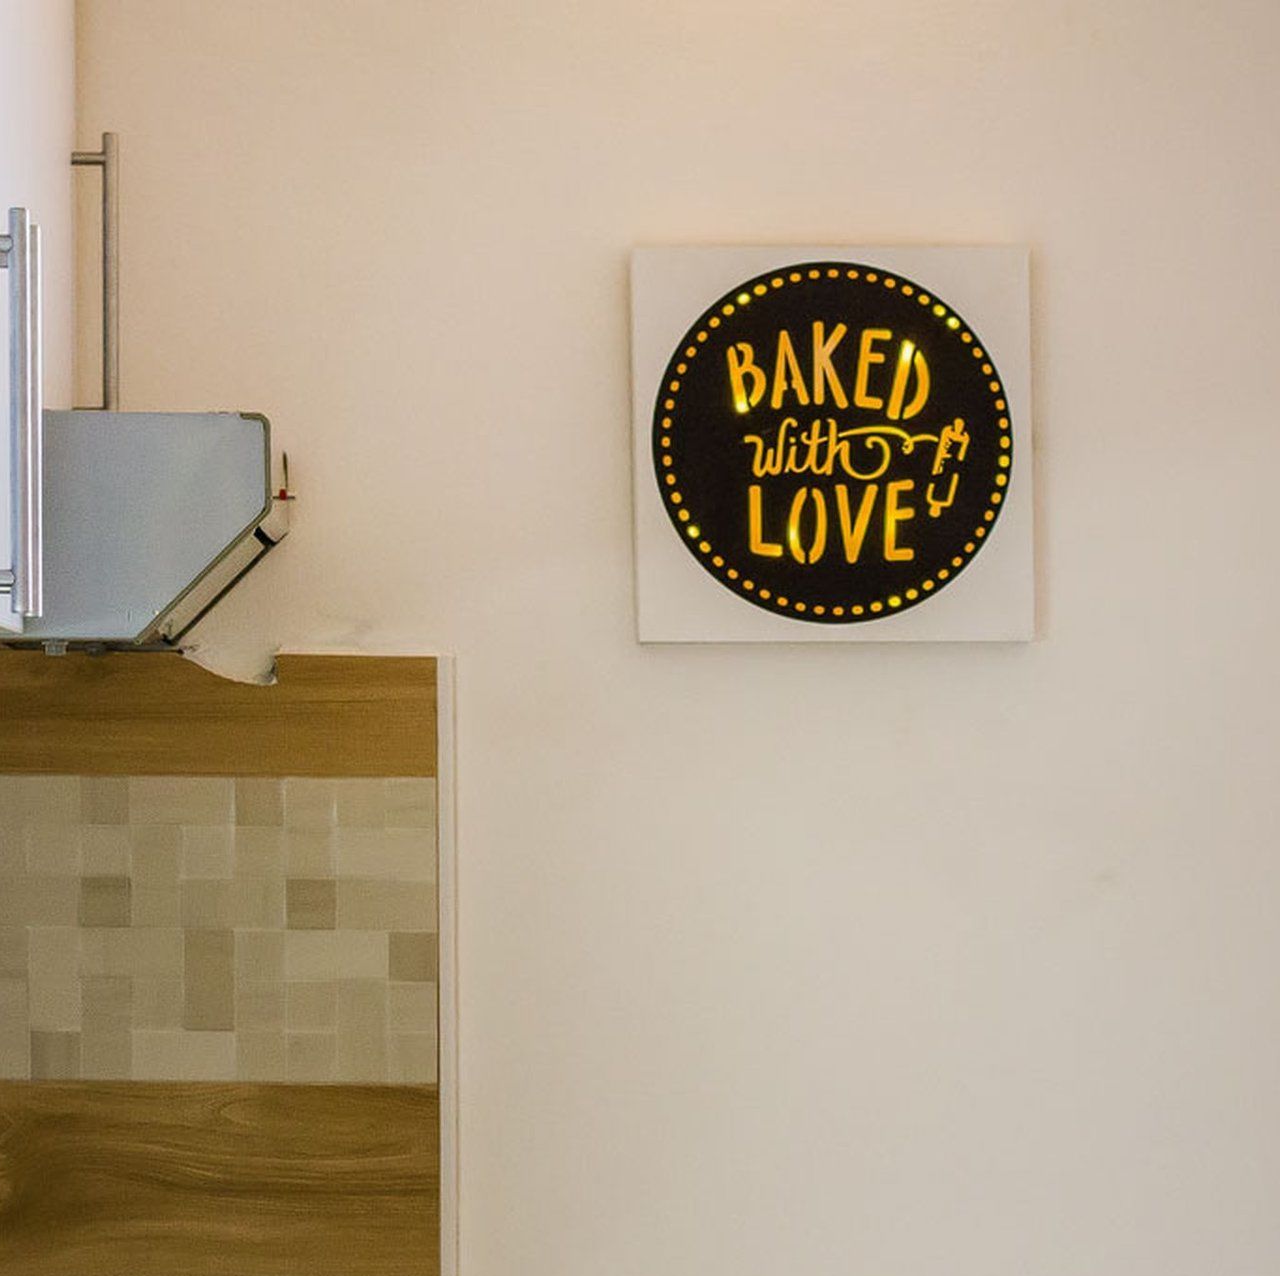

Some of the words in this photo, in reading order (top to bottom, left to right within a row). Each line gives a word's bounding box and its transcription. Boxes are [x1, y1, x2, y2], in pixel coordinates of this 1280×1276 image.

[726, 320, 931, 420] BAKED
[743, 418, 891, 481] With
[748, 479, 915, 564] LOVE
